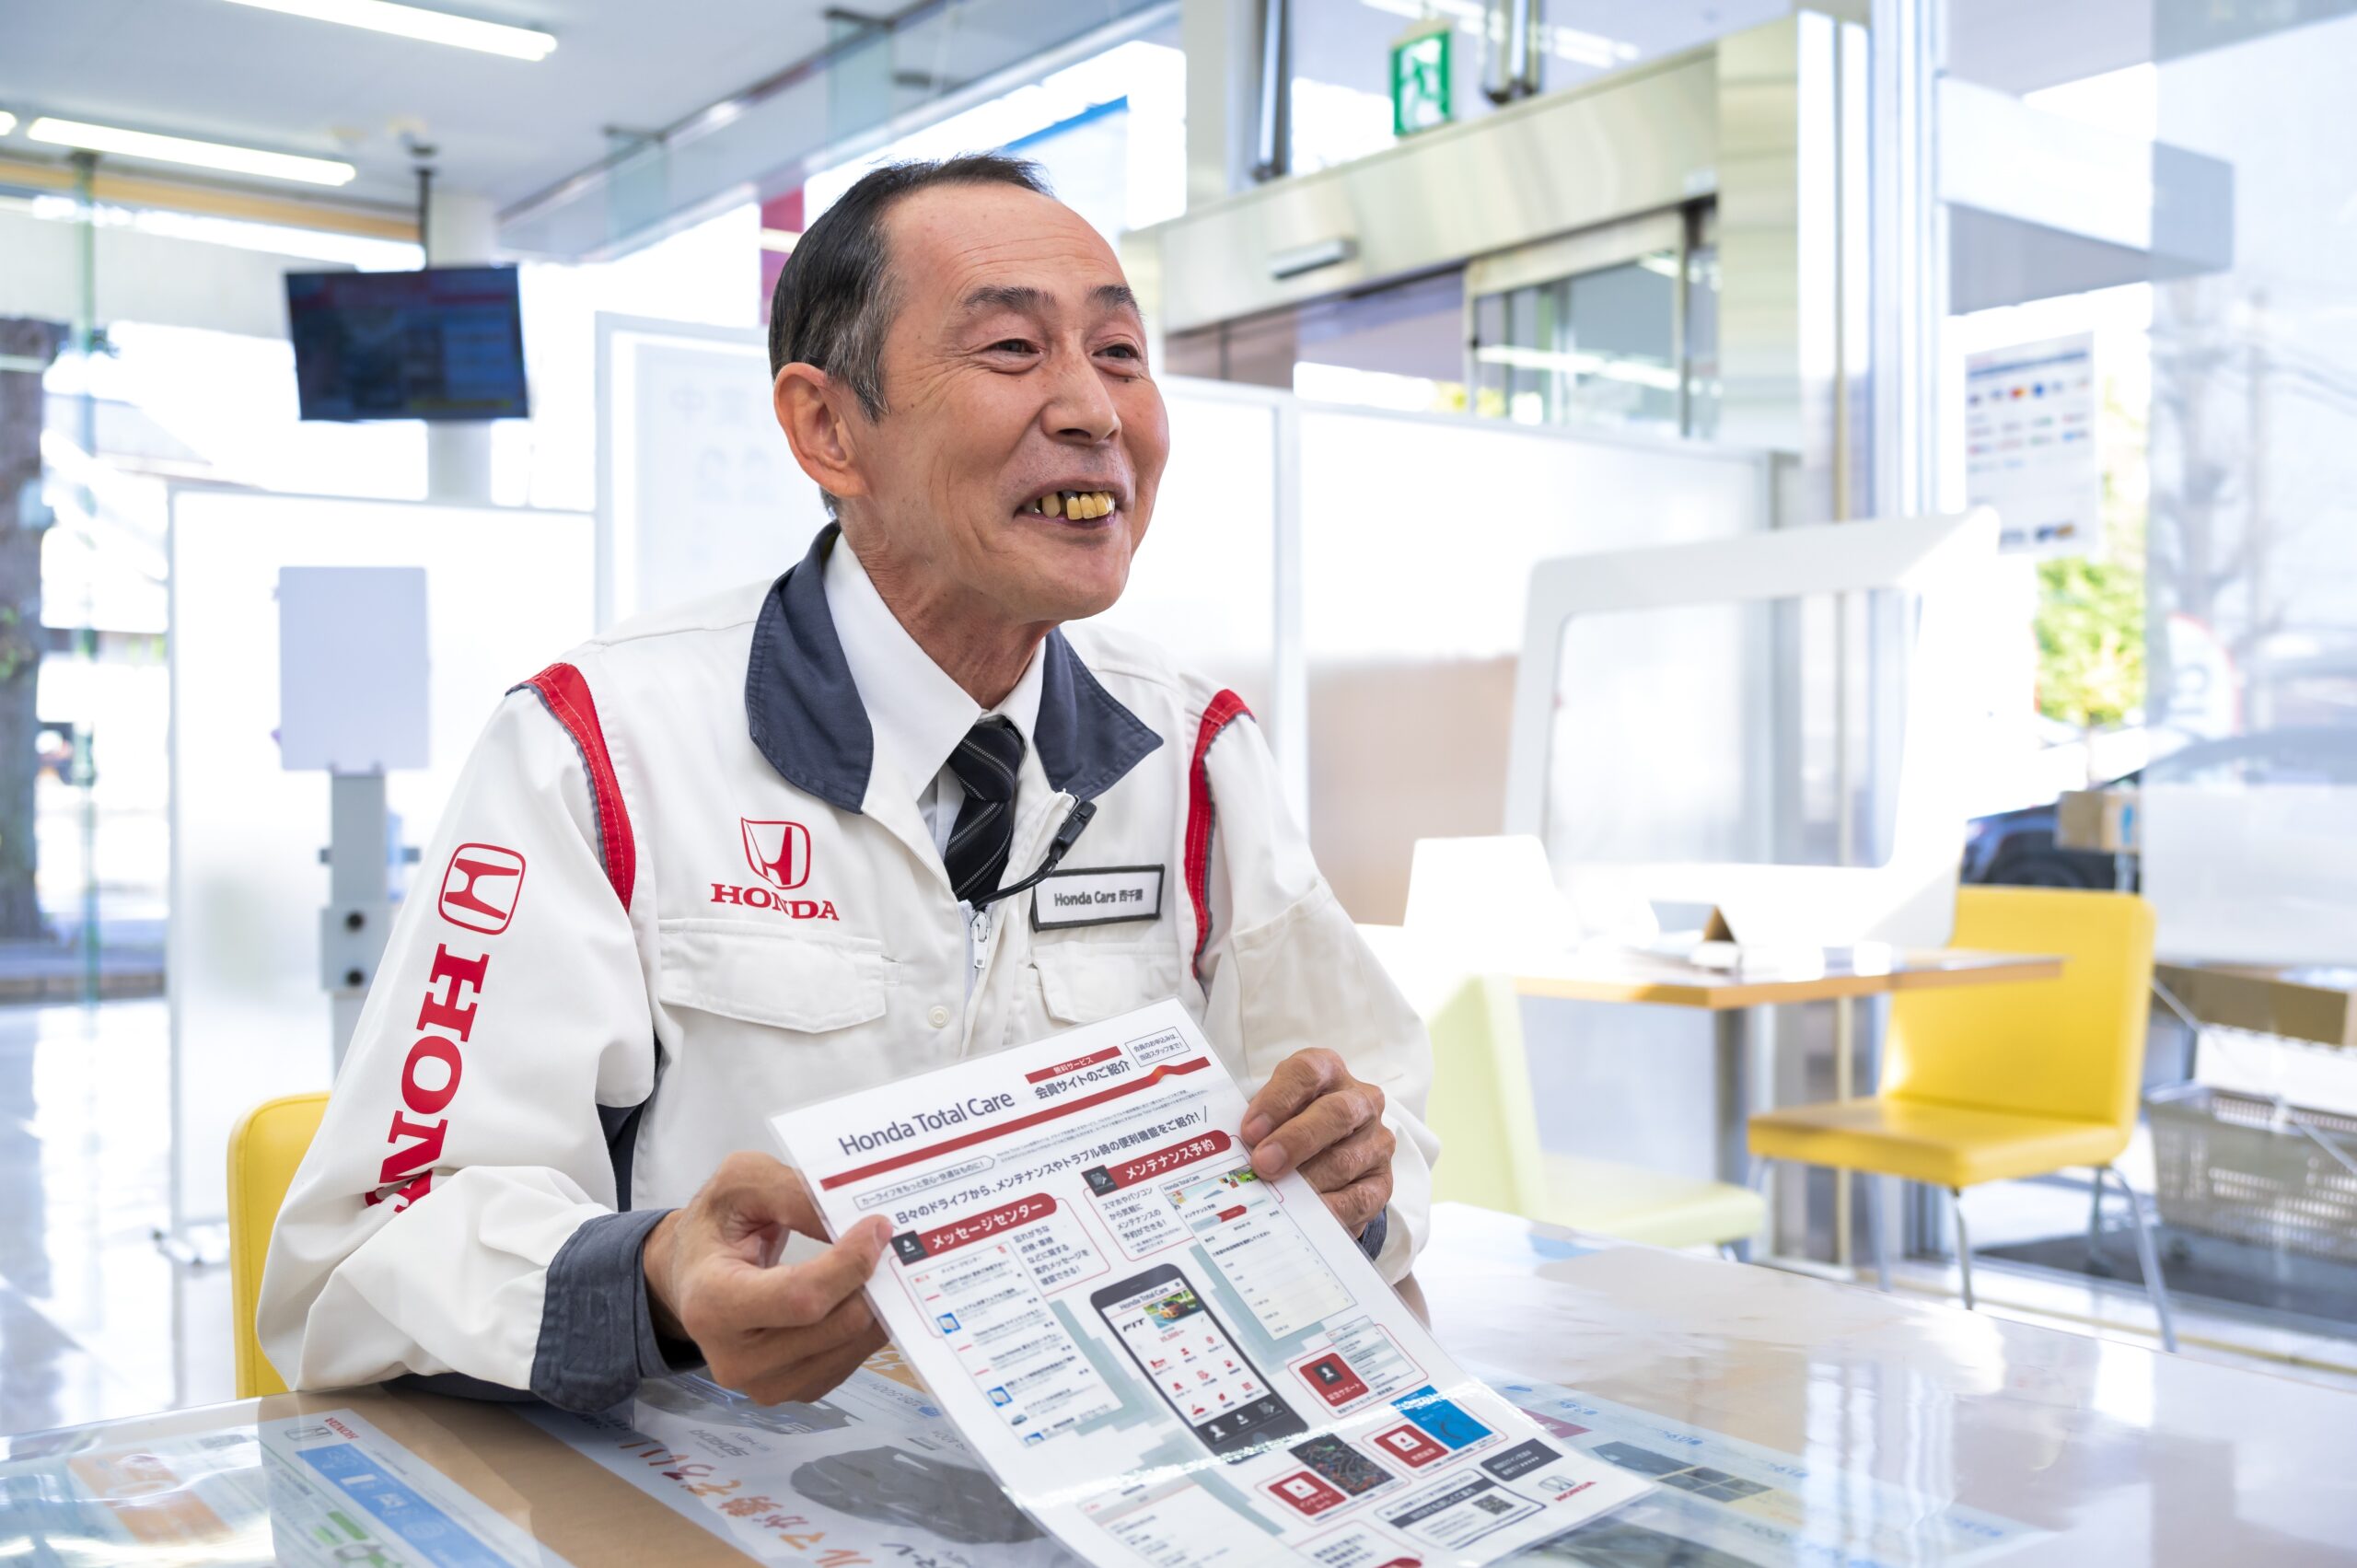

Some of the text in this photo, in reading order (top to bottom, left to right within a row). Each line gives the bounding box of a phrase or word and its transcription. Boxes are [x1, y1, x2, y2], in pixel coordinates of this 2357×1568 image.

[711, 883, 840, 921] HONDA
[1054, 893, 1092, 906] Honda
[1095, 890, 1116, 903] Cars
[1051, 1056, 1094, 1074] 無料サービス
[365, 943, 490, 1214] HON
[1032, 1059, 1133, 1099] 会員サイトのご紹介
[838, 1090, 1016, 1156] Honda Total Care
[1121, 1138, 1218, 1179] メンテナンス予約
[1100, 1186, 1155, 1210] スマホやパソコン
[1107, 1202, 1144, 1220] から気軽に
[1114, 1208, 1162, 1230] メンテナンスの
[927, 1200, 1045, 1249] メッセージセンター
[1012, 1225, 1051, 1243] 忘れがちな
[1120, 1219, 1168, 1241] 予約ができる！
[1025, 1243, 1071, 1263] などに関する
[1032, 1248, 1090, 1275] 案内メッセージを
[1119, 1286, 1169, 1309] Honda Total Care
[1120, 1317, 1148, 1331] FIT
[323, 1417, 360, 1440] HONDA
[1554, 1481, 1596, 1502] HONDA
